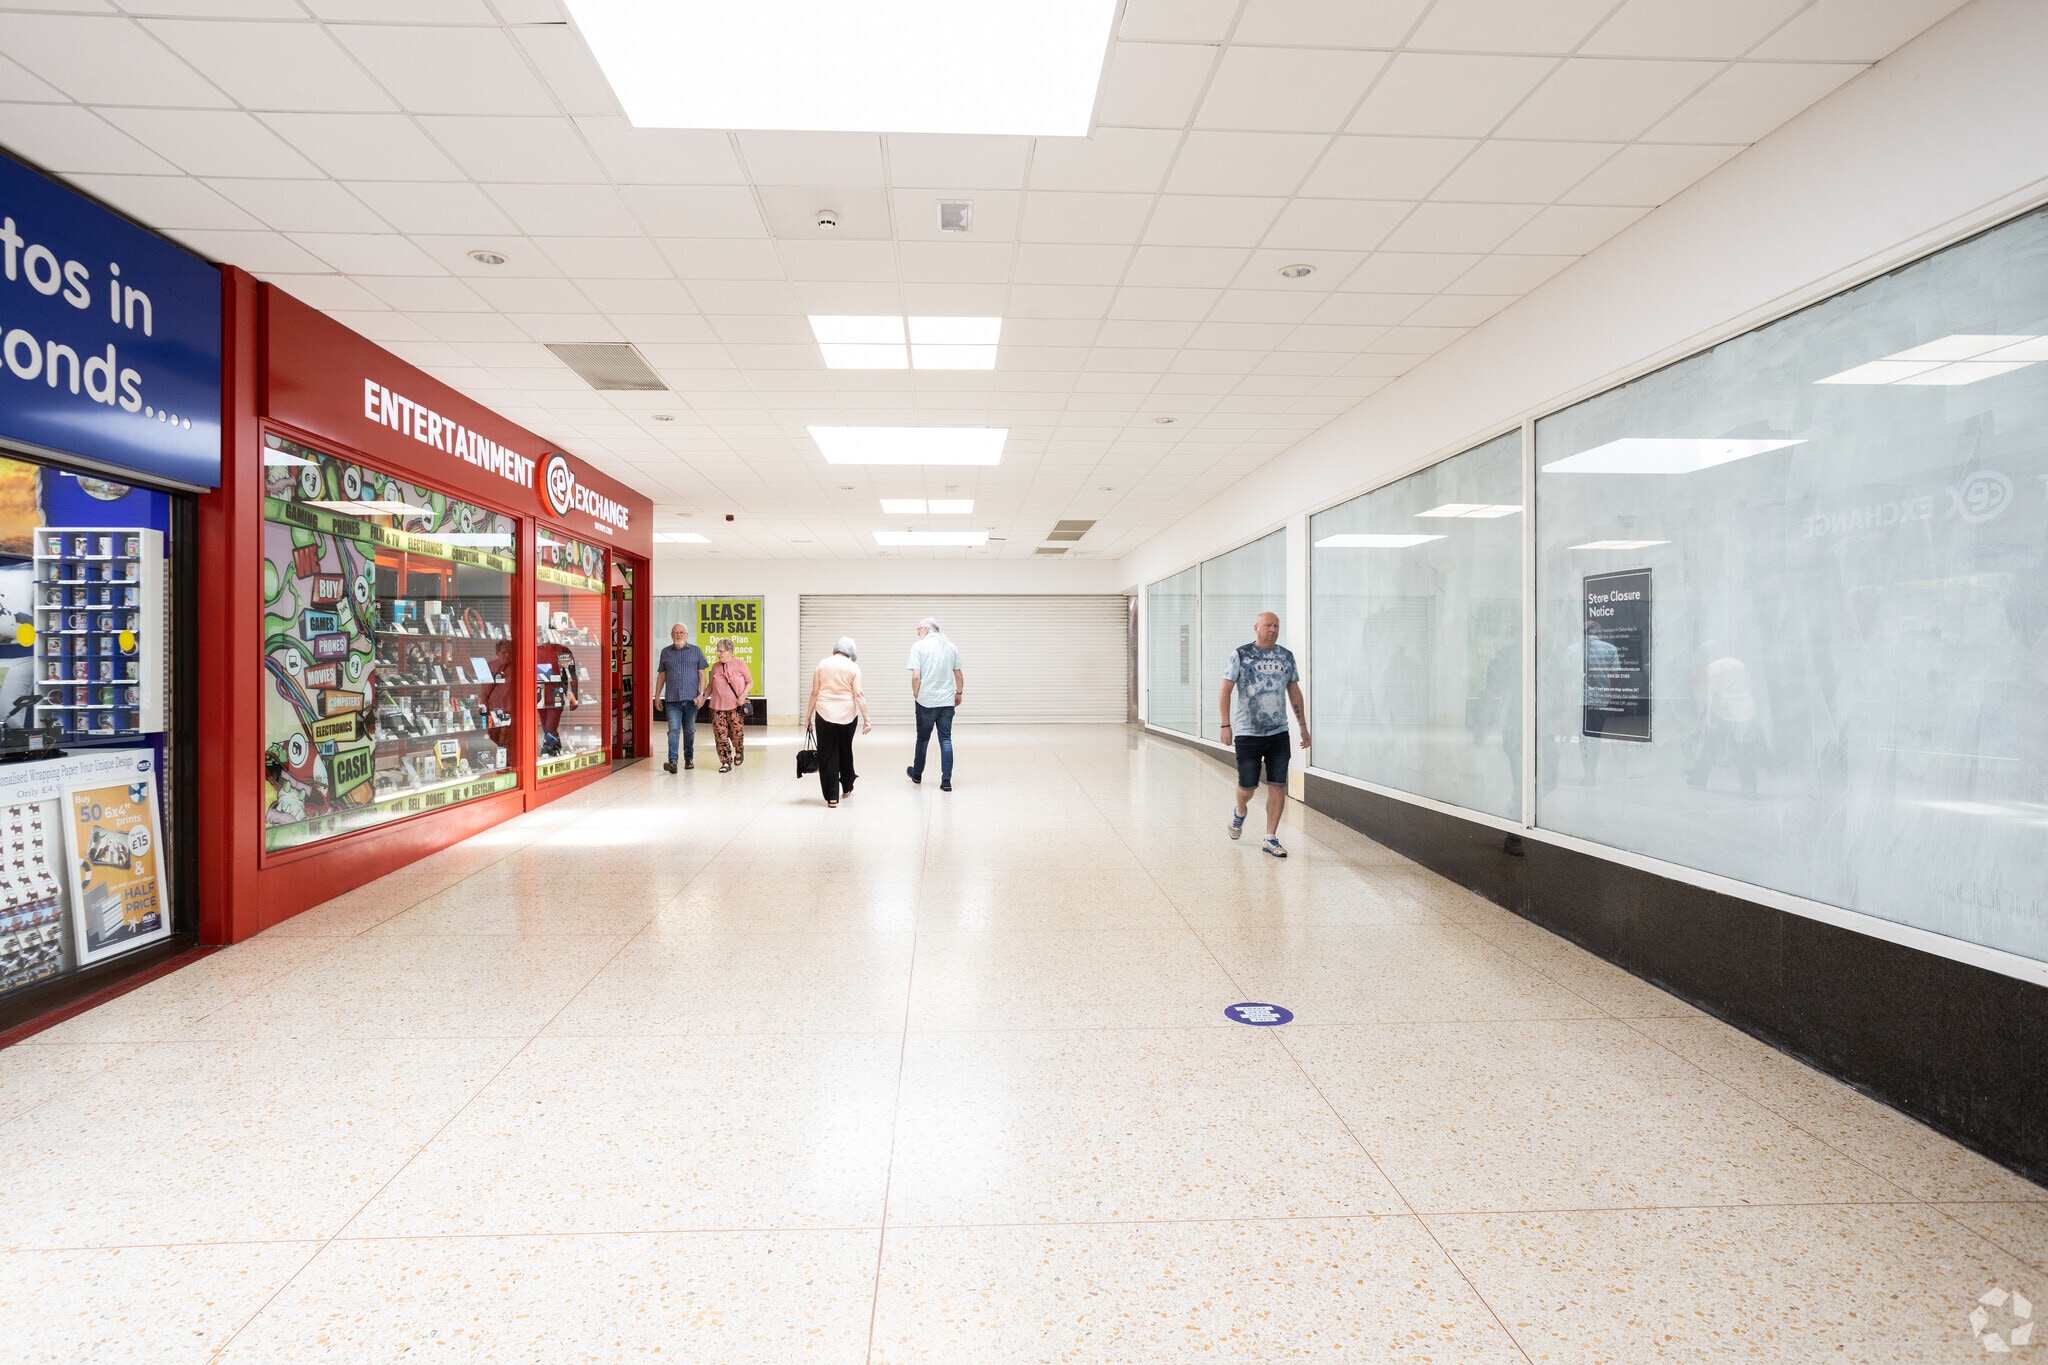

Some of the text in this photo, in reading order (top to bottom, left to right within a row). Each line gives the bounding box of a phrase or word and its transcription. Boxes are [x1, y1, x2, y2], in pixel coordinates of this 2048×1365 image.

[110, 262, 152, 337] in
[0, 328, 191, 430] onds....
[365, 378, 535, 489] ENTERTAINMENT
[575, 483, 629, 530] EXCHANGE
[286, 503, 318, 529] GAMING
[332, 519, 360, 536] PHONES
[371, 525, 385, 543] FILM
[386, 533, 391, 544] &
[392, 533, 400, 548] TV
[408, 537, 443, 556] ELECTRONICS
[452, 548, 479, 563] COMPUTING
[320, 580, 339, 599] BUY
[1588, 590, 1640, 604] Store Closure
[701, 603, 757, 621] LEASE
[1589, 605, 1615, 617] Notice
[310, 617, 334, 631] GAMES
[701, 622, 757, 634] FOR SALE
[319, 639, 344, 653] PHONES
[732, 635, 749, 645] Plan
[733, 646, 752, 655] pace
[307, 668, 334, 686] MOVIES
[329, 697, 361, 708] COMPUTERS
[316, 721, 352, 738] ELECTRONICS
[324, 743, 332, 753] for
[30, 764, 60, 784] Wrapping
[61, 763, 78, 779] Paper
[80, 761, 94, 776] Your
[94, 758, 115, 773] Unique
[115, 755, 134, 770] Design
[337, 753, 368, 785] CASH
[17, 786, 39, 799] Only
[75, 795, 91, 804] Buy
[408, 798, 421, 811] SELL
[426, 792, 446, 806] DONATE
[453, 788, 461, 801] WE
[472, 781, 496, 796] RECYCLING
[80, 803, 103, 823] 50
[116, 814, 142, 828] prints
[132, 834, 149, 850] £15
[135, 860, 145, 876] &
[125, 882, 155, 900] HALF
[126, 896, 157, 914] PRICE
